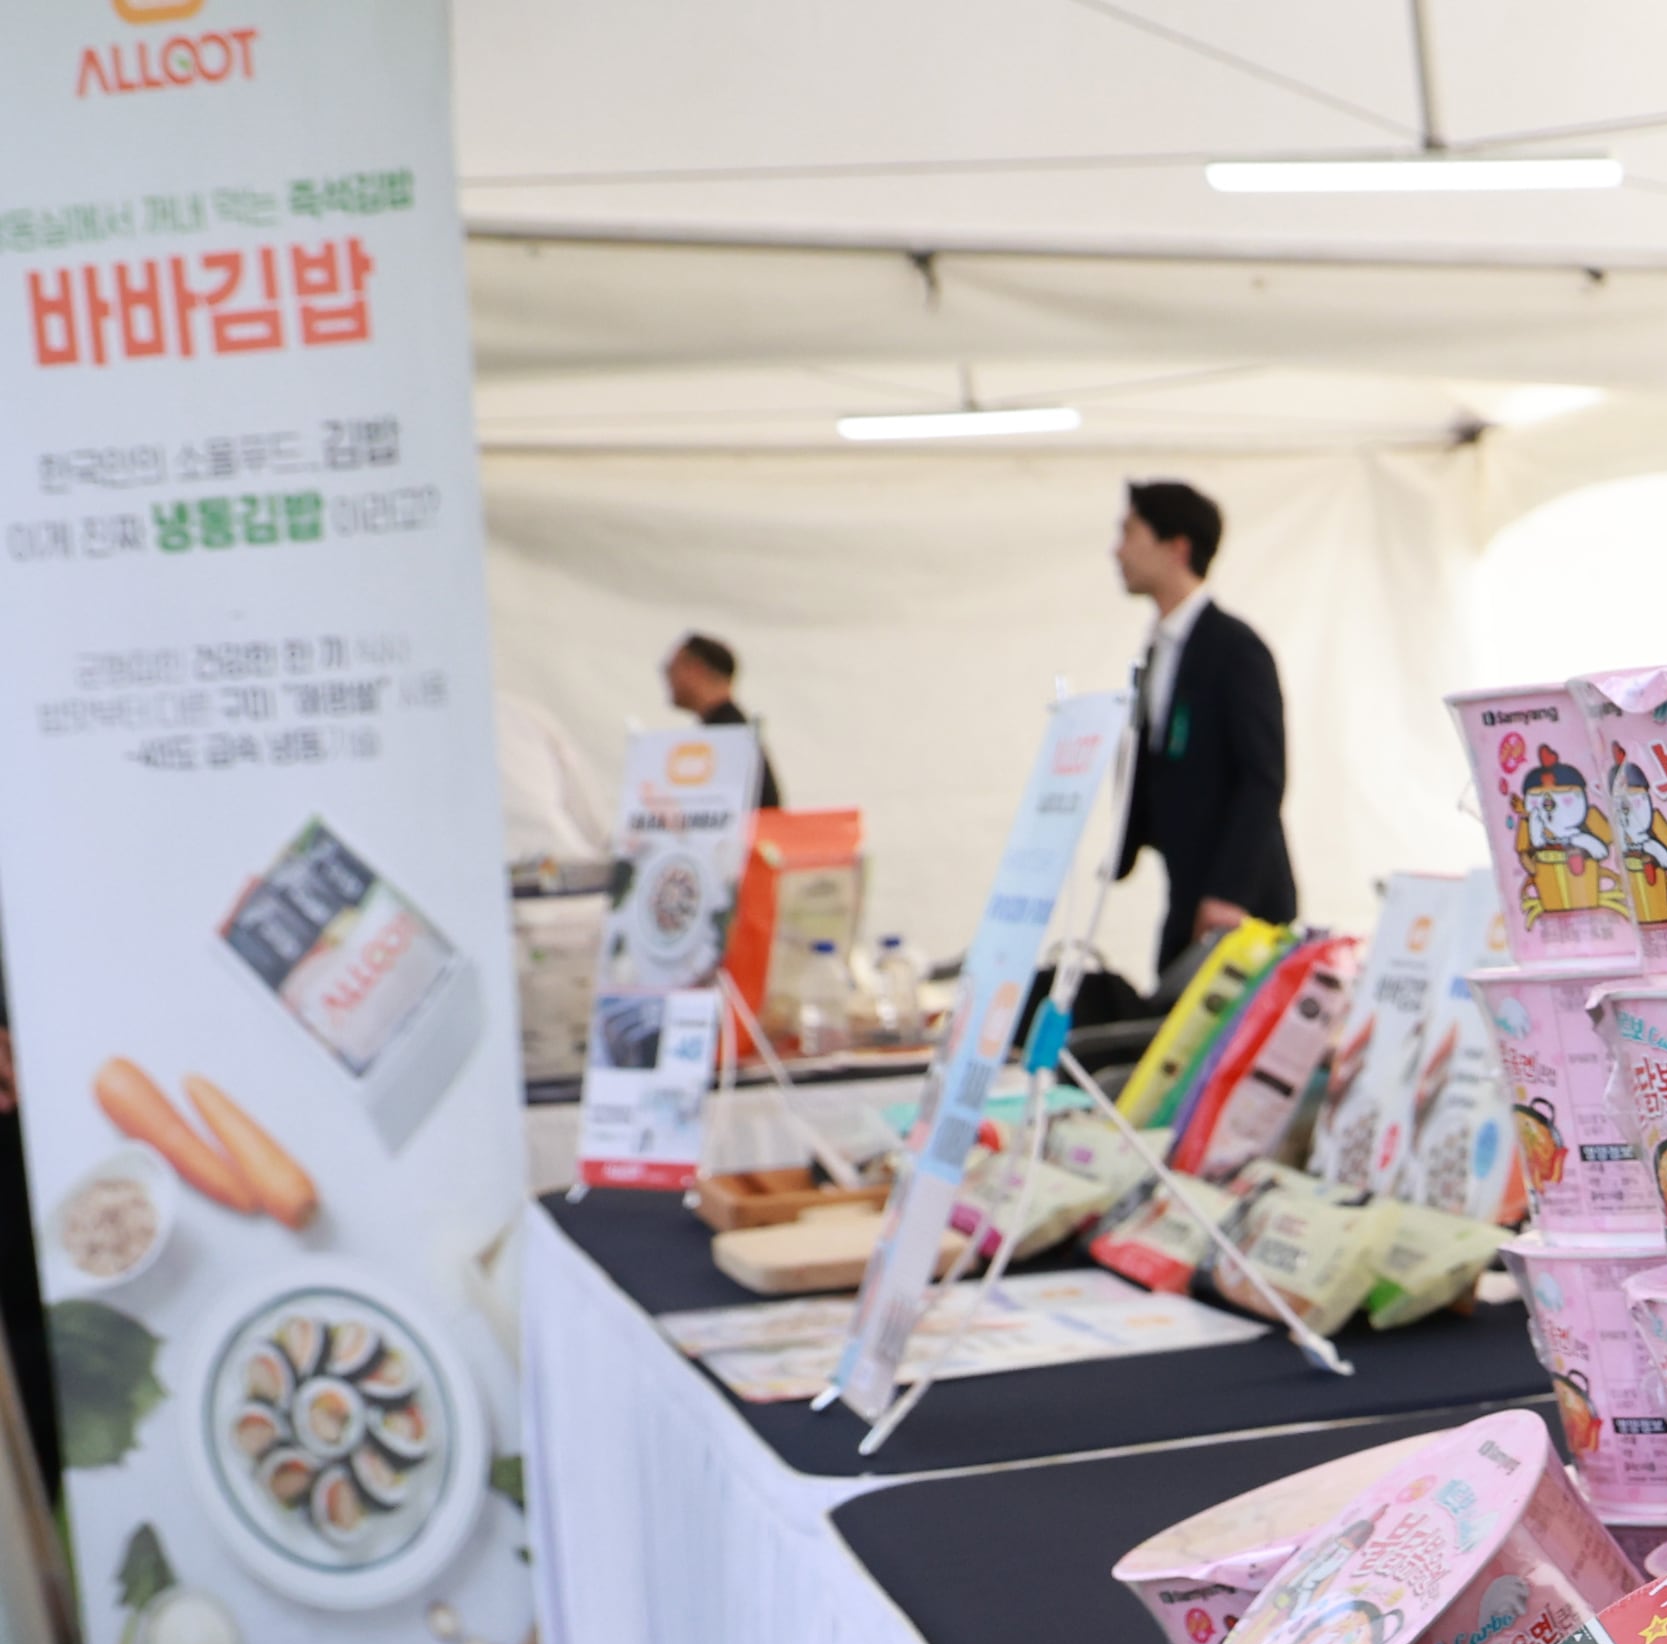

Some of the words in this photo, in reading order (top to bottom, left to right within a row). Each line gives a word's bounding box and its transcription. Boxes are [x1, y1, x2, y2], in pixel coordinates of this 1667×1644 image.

[26, 236, 376, 367] 바바김밥
[321, 414, 401, 471] 김밥
[152, 489, 325, 554] 냉동김밥
